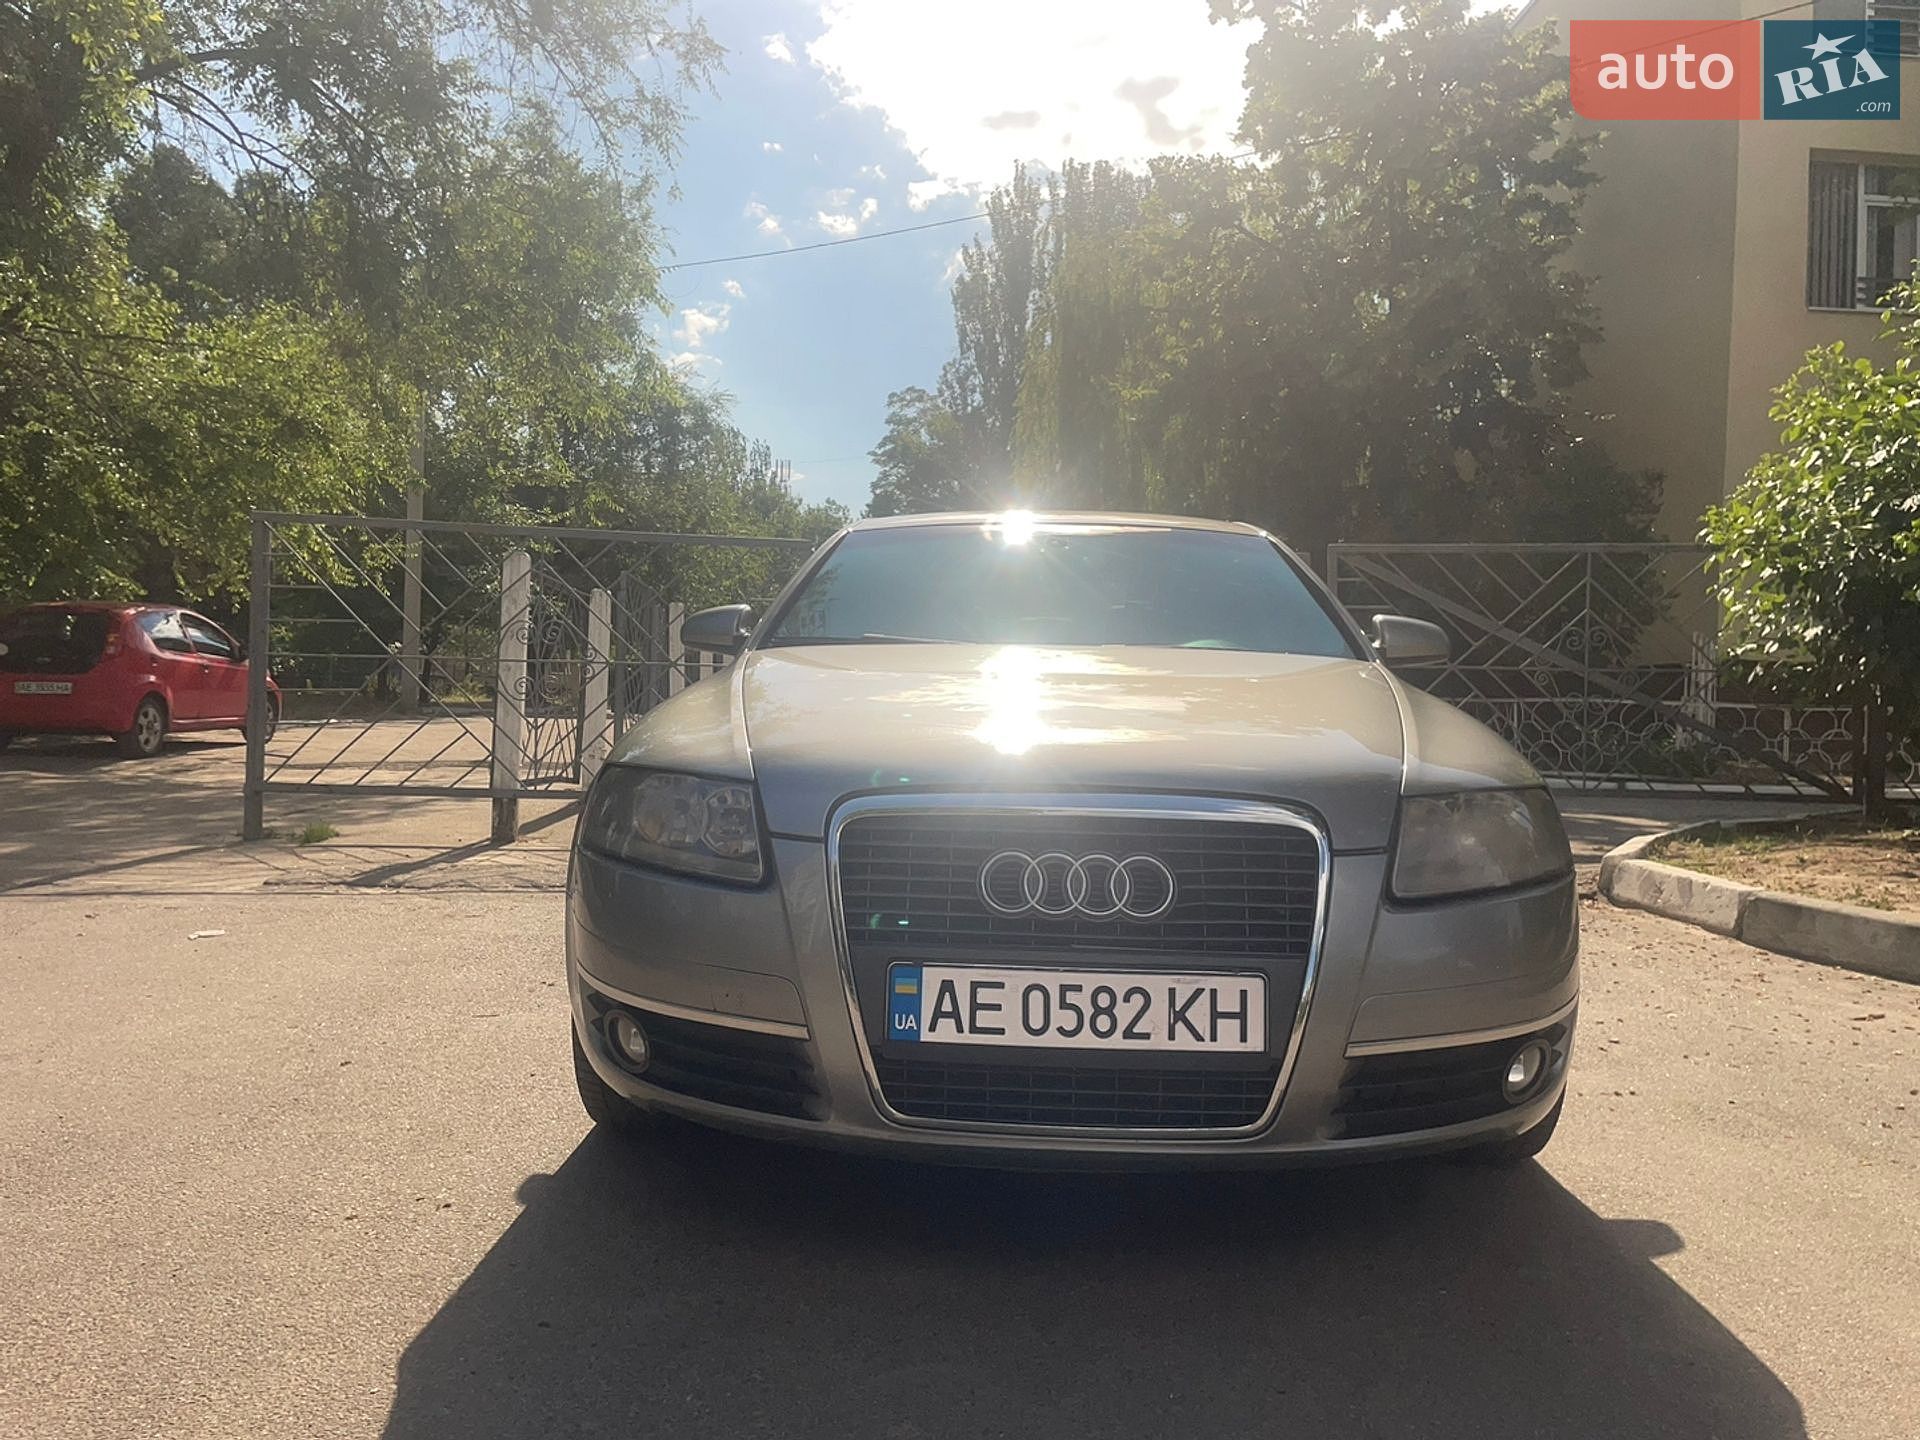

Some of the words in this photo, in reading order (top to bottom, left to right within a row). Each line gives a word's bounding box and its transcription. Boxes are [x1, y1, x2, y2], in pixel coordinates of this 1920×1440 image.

[894, 1013, 918, 1031] UA
[928, 978, 1006, 1036] AE
[1021, 982, 1152, 1041] 0582
[1167, 987, 1248, 1043] KH
